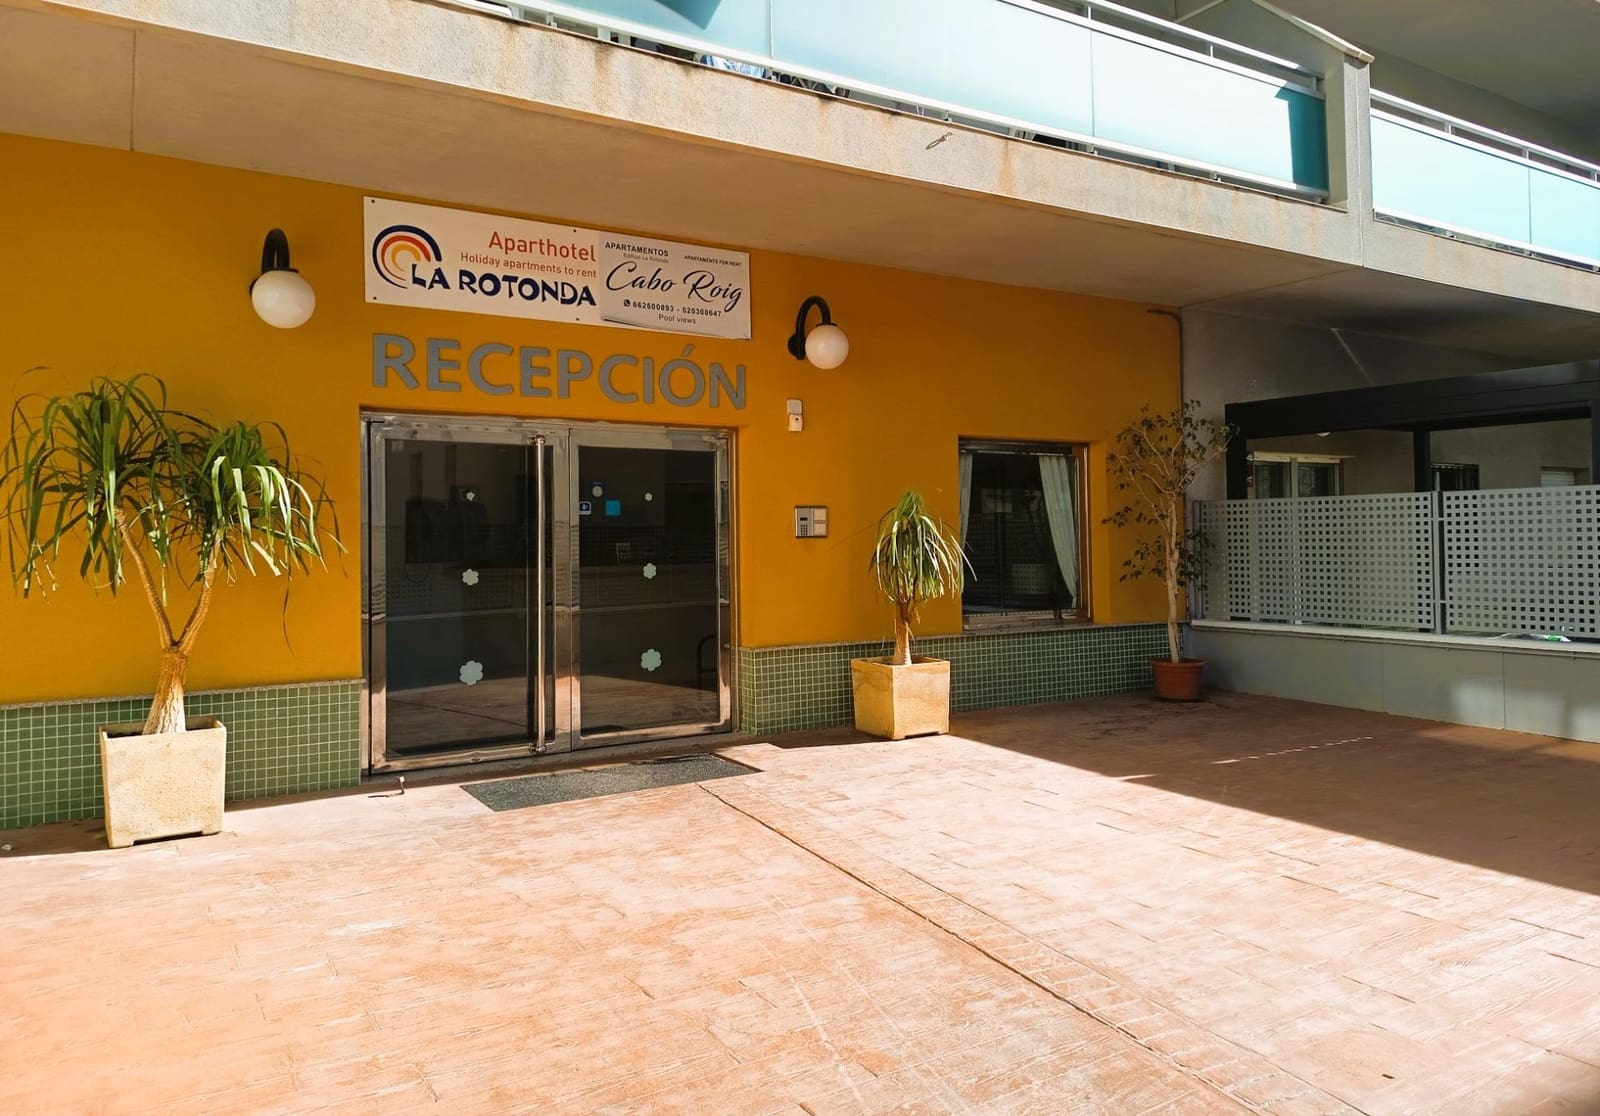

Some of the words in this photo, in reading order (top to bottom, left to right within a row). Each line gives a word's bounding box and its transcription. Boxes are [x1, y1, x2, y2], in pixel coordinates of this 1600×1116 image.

[489, 231, 596, 262] Aparthotel
[605, 241, 669, 257] APARTAMENTOS
[460, 252, 500, 268] Holiday
[503, 258, 561, 275] apartments
[564, 266, 574, 276] to
[576, 269, 597, 278] rent
[411, 263, 451, 290] LA
[459, 269, 597, 306] ROTONDA
[606, 261, 676, 292] Cabo
[683, 270, 743, 313] Roig
[632, 301, 674, 312] 662600893
[658, 313, 675, 323] Pool
[677, 317, 697, 325] views
[372, 333, 747, 410] RECEPCIÓN
